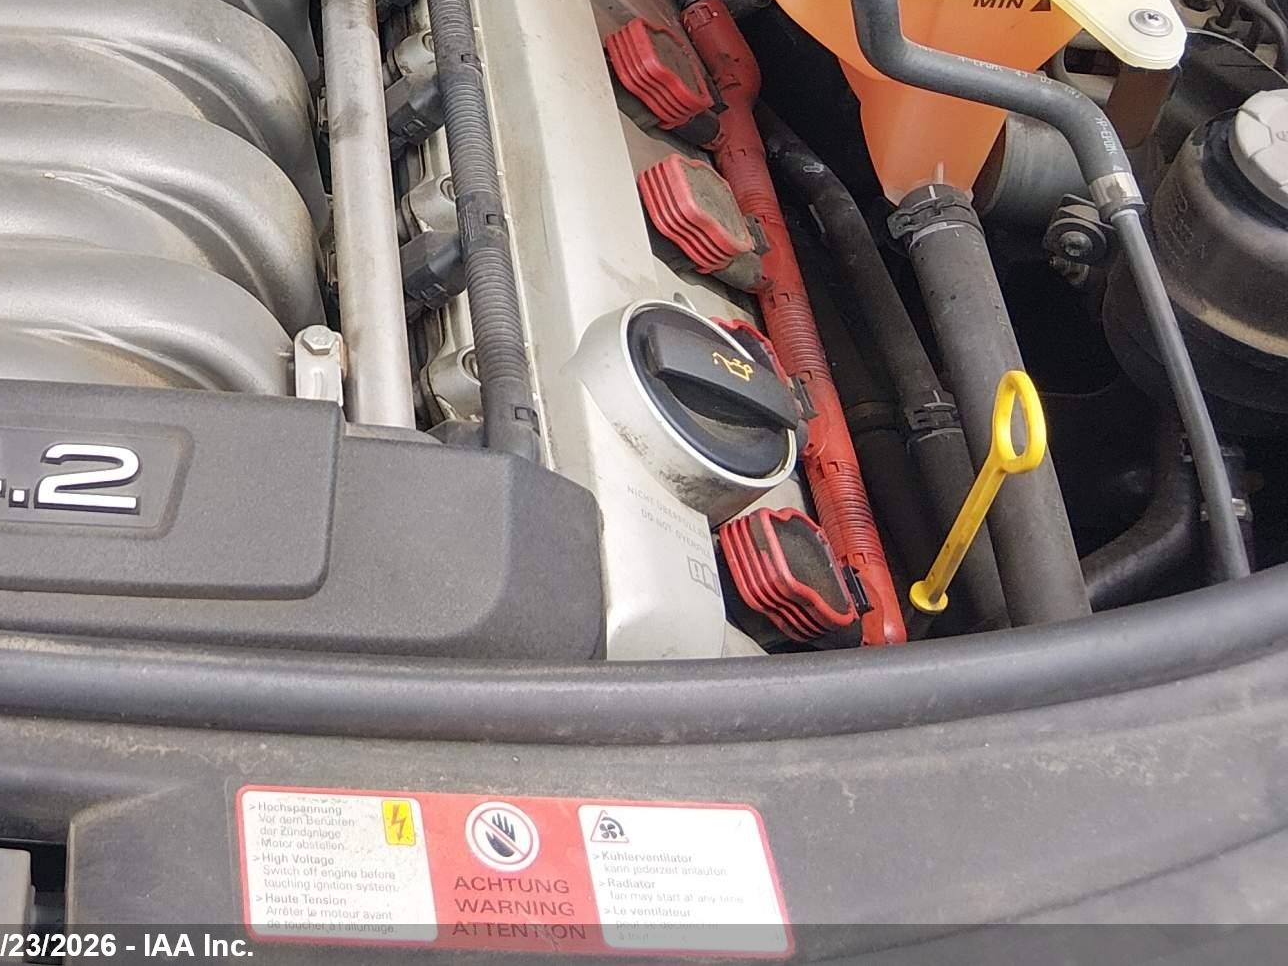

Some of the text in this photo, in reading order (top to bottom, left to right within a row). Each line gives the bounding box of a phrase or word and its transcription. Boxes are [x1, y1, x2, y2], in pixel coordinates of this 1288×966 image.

[258, 802, 342, 816] Hochspannung
[262, 853, 334, 866] High Voltage
[263, 865, 395, 880] Switch off engine before
[604, 864, 629, 873] kann
[264, 878, 310, 891] touching
[313, 879, 352, 892] ignition
[454, 875, 571, 895] ACHTUNG
[607, 878, 655, 889] Radiator
[265, 893, 346, 905] Haute Tension
[454, 898, 576, 918] WARNING
[321, 910, 359, 919] moteur
[363, 911, 392, 920] avant
[284, 920, 324, 931] toucher
[452, 920, 587, 941] ATTENTION
